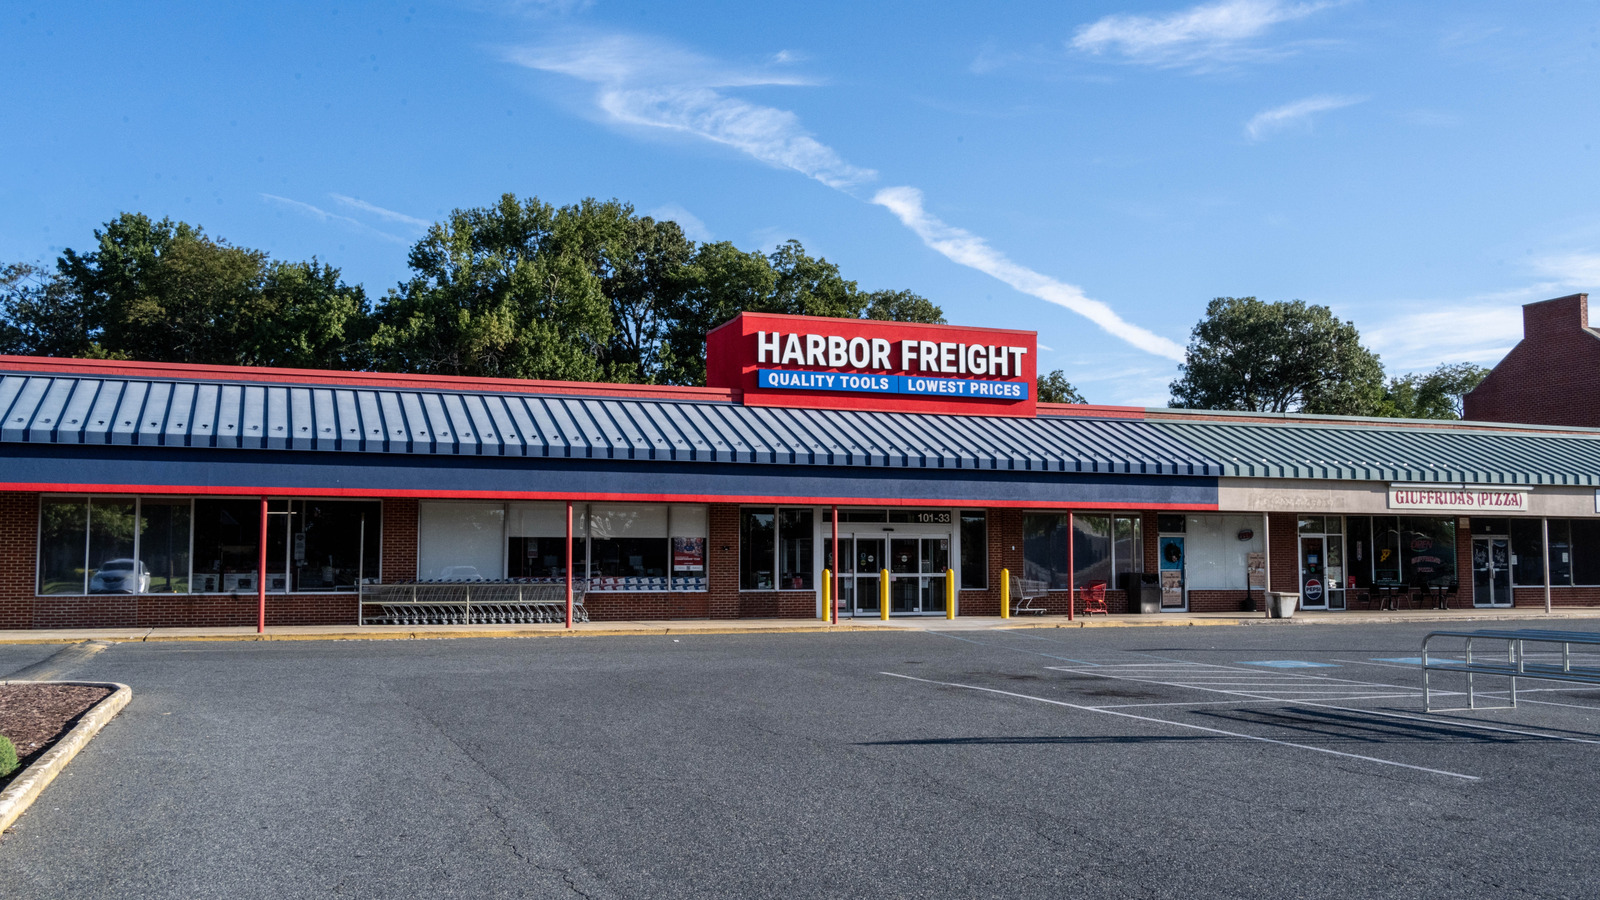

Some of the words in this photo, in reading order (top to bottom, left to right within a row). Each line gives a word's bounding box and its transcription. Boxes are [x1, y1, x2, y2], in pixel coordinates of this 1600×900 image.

[757, 331, 892, 369] HARBOR
[901, 340, 1028, 377] FREIGHT
[768, 372, 835, 388] QUALITY
[840, 375, 889, 390] TOOLS
[908, 379, 965, 394] LOWEST
[970, 382, 1021, 397] PRICES
[1478, 492, 1523, 508] (PIZZA)
[917, 513, 950, 523] 101-33
